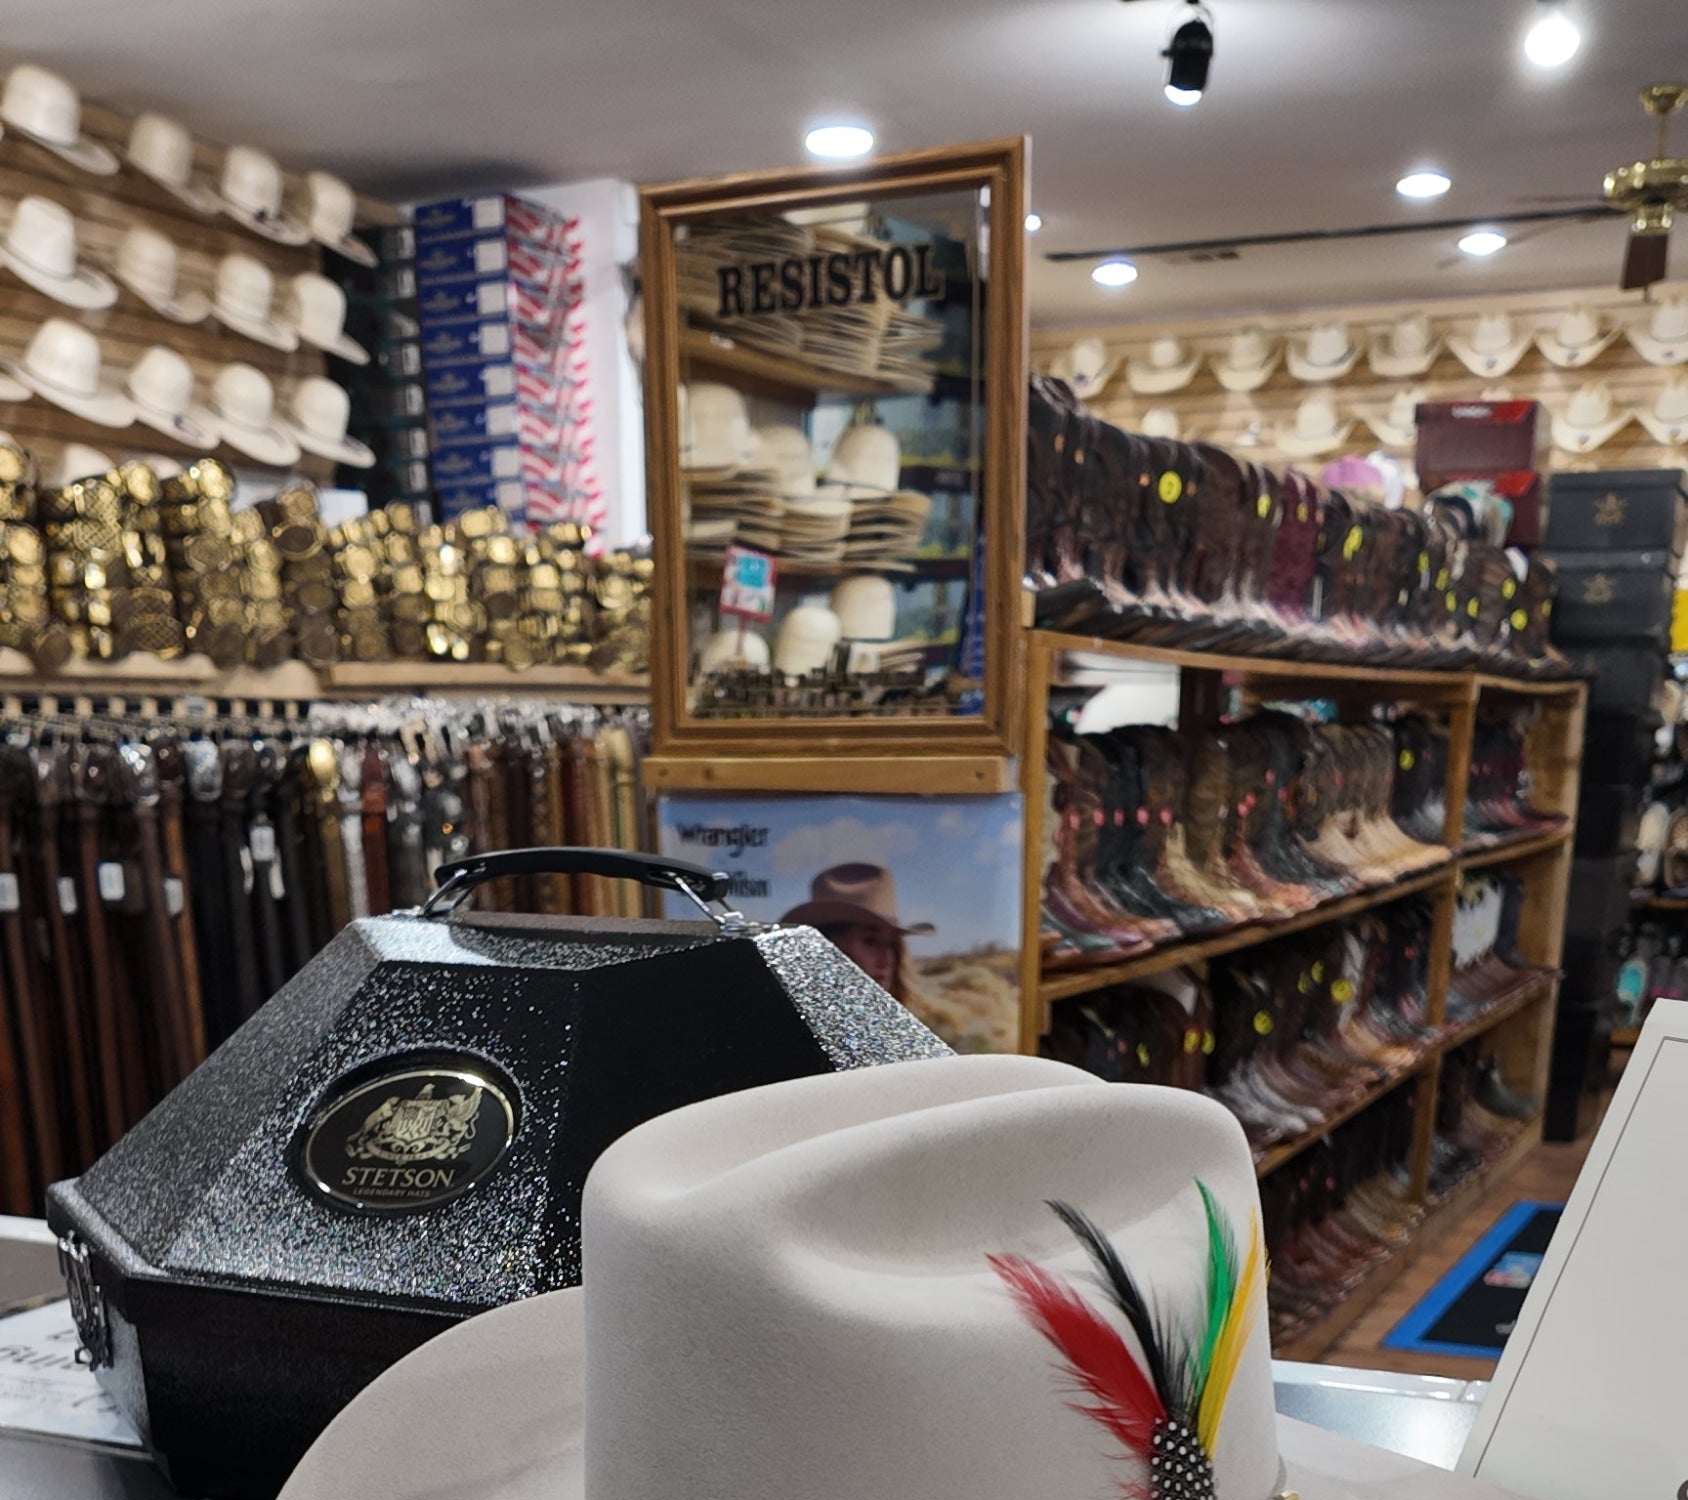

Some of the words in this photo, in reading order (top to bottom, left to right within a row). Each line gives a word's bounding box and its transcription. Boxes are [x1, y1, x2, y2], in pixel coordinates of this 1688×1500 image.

[718, 244, 940, 317] RESISTOL
[342, 1166, 455, 1189] STETSON
[353, 1187, 405, 1198] LEGENDARY
